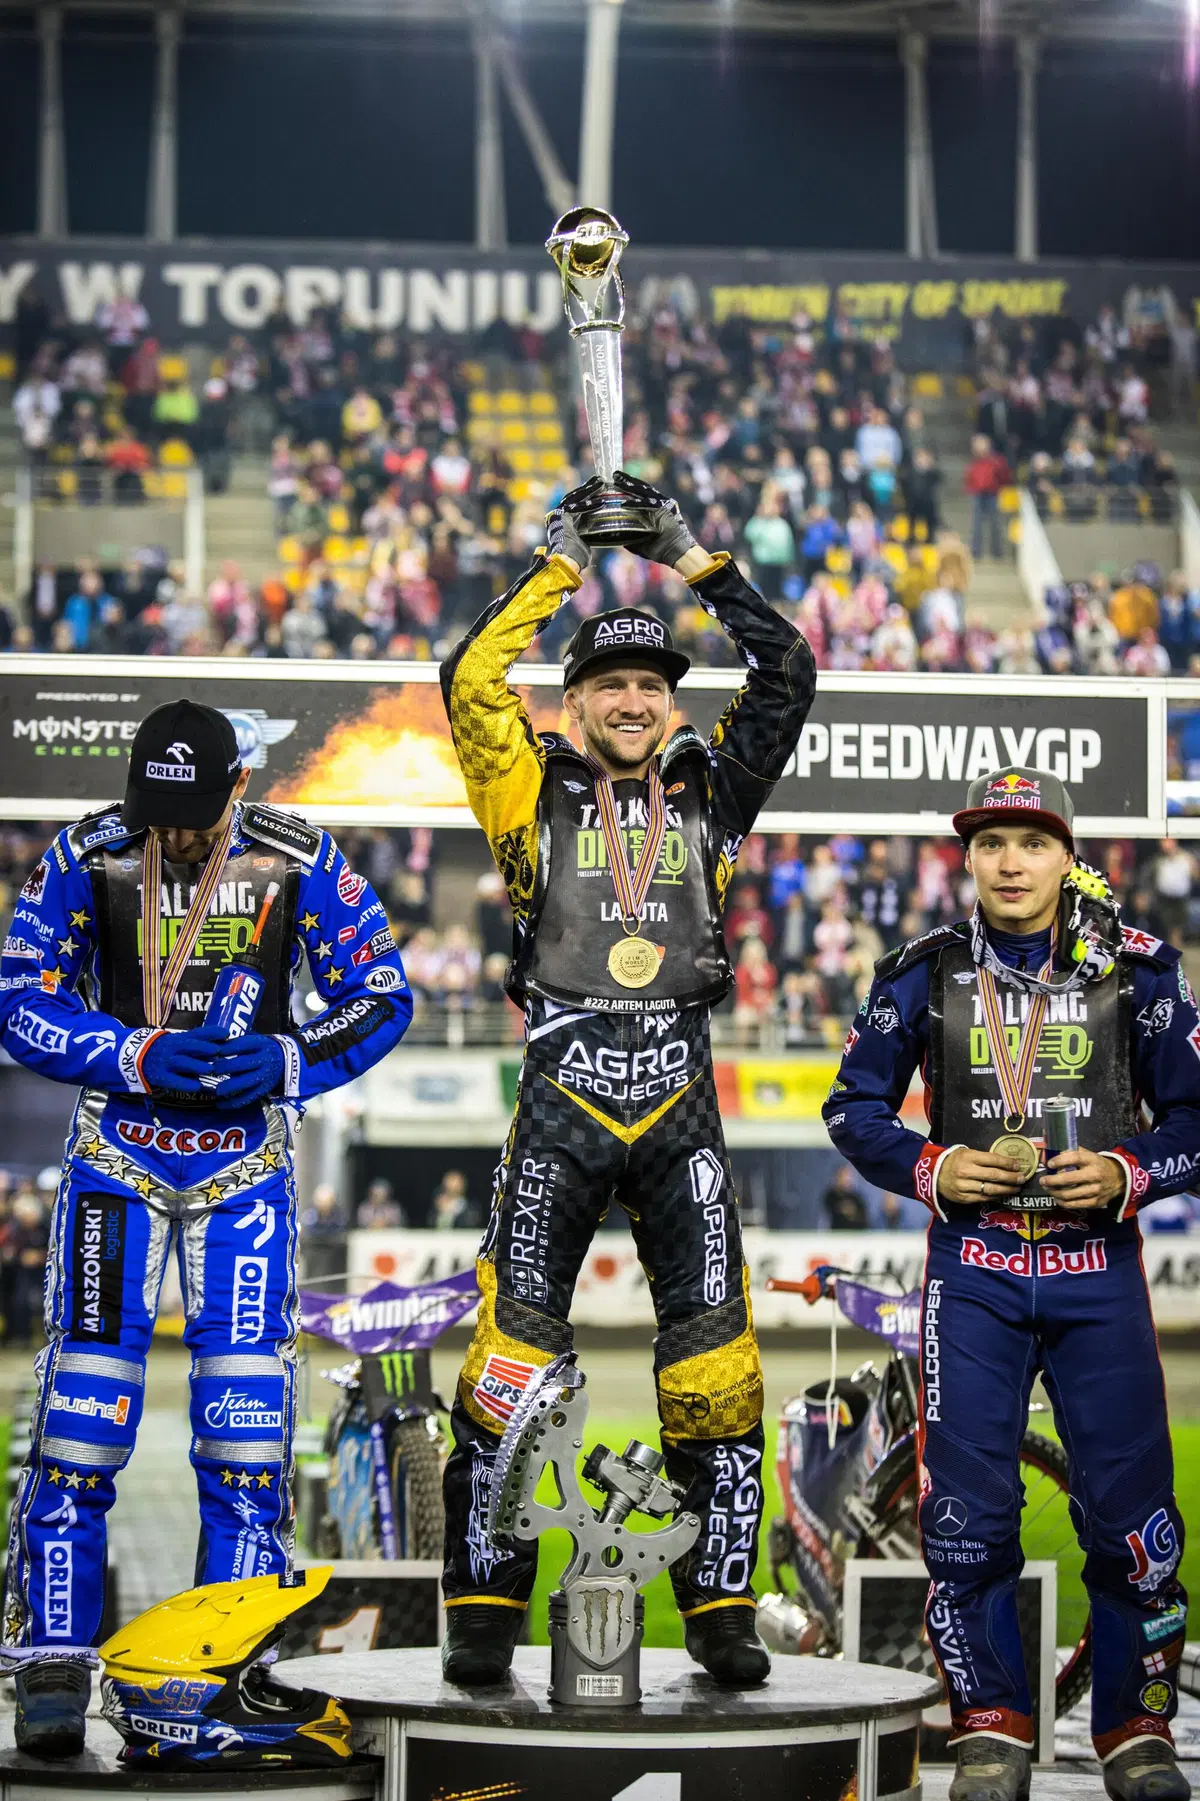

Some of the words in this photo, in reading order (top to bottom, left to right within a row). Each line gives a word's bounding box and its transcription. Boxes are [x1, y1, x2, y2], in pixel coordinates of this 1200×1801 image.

[60, 261, 143, 323] W
[594, 619, 664, 641] AGRO
[13, 715, 140, 743] MONSTE
[148, 763, 193, 780] ORLEN
[984, 794, 1010, 807] Red
[1012, 795, 1040, 809] Bull
[87, 827, 125, 844] ORLEN
[253, 815, 312, 845] MASZOŃSKI
[601, 902, 668, 922] LAUTA
[583, 996, 609, 1009] #222
[611, 997, 643, 1011] ARTEM
[645, 998, 677, 1011] LAGUTA
[559, 1039, 689, 1081] AGRO
[558, 1069, 689, 1100] PROJECTS
[116, 1119, 246, 1156] wecon
[510, 1158, 547, 1264] REXER
[538, 1163, 560, 1266] engineering
[103, 1210, 120, 1261] logistic
[82, 1208, 103, 1333] MASZOŃSKI
[703, 1204, 727, 1306] PRES
[961, 1237, 1032, 1277] Red
[1037, 1238, 1107, 1277] Bull
[235, 1262, 264, 1344] ORLEN
[925, 1279, 944, 1422] POLCOPPER
[51, 1391, 131, 1425] budnex
[233, 1413, 279, 1425] ORLEN
[720, 1444, 762, 1592] AGRO
[947, 1550, 989, 1563] FRELIK
[48, 1546, 69, 1631] ORLEN
[133, 1718, 194, 1741] ORLEN
